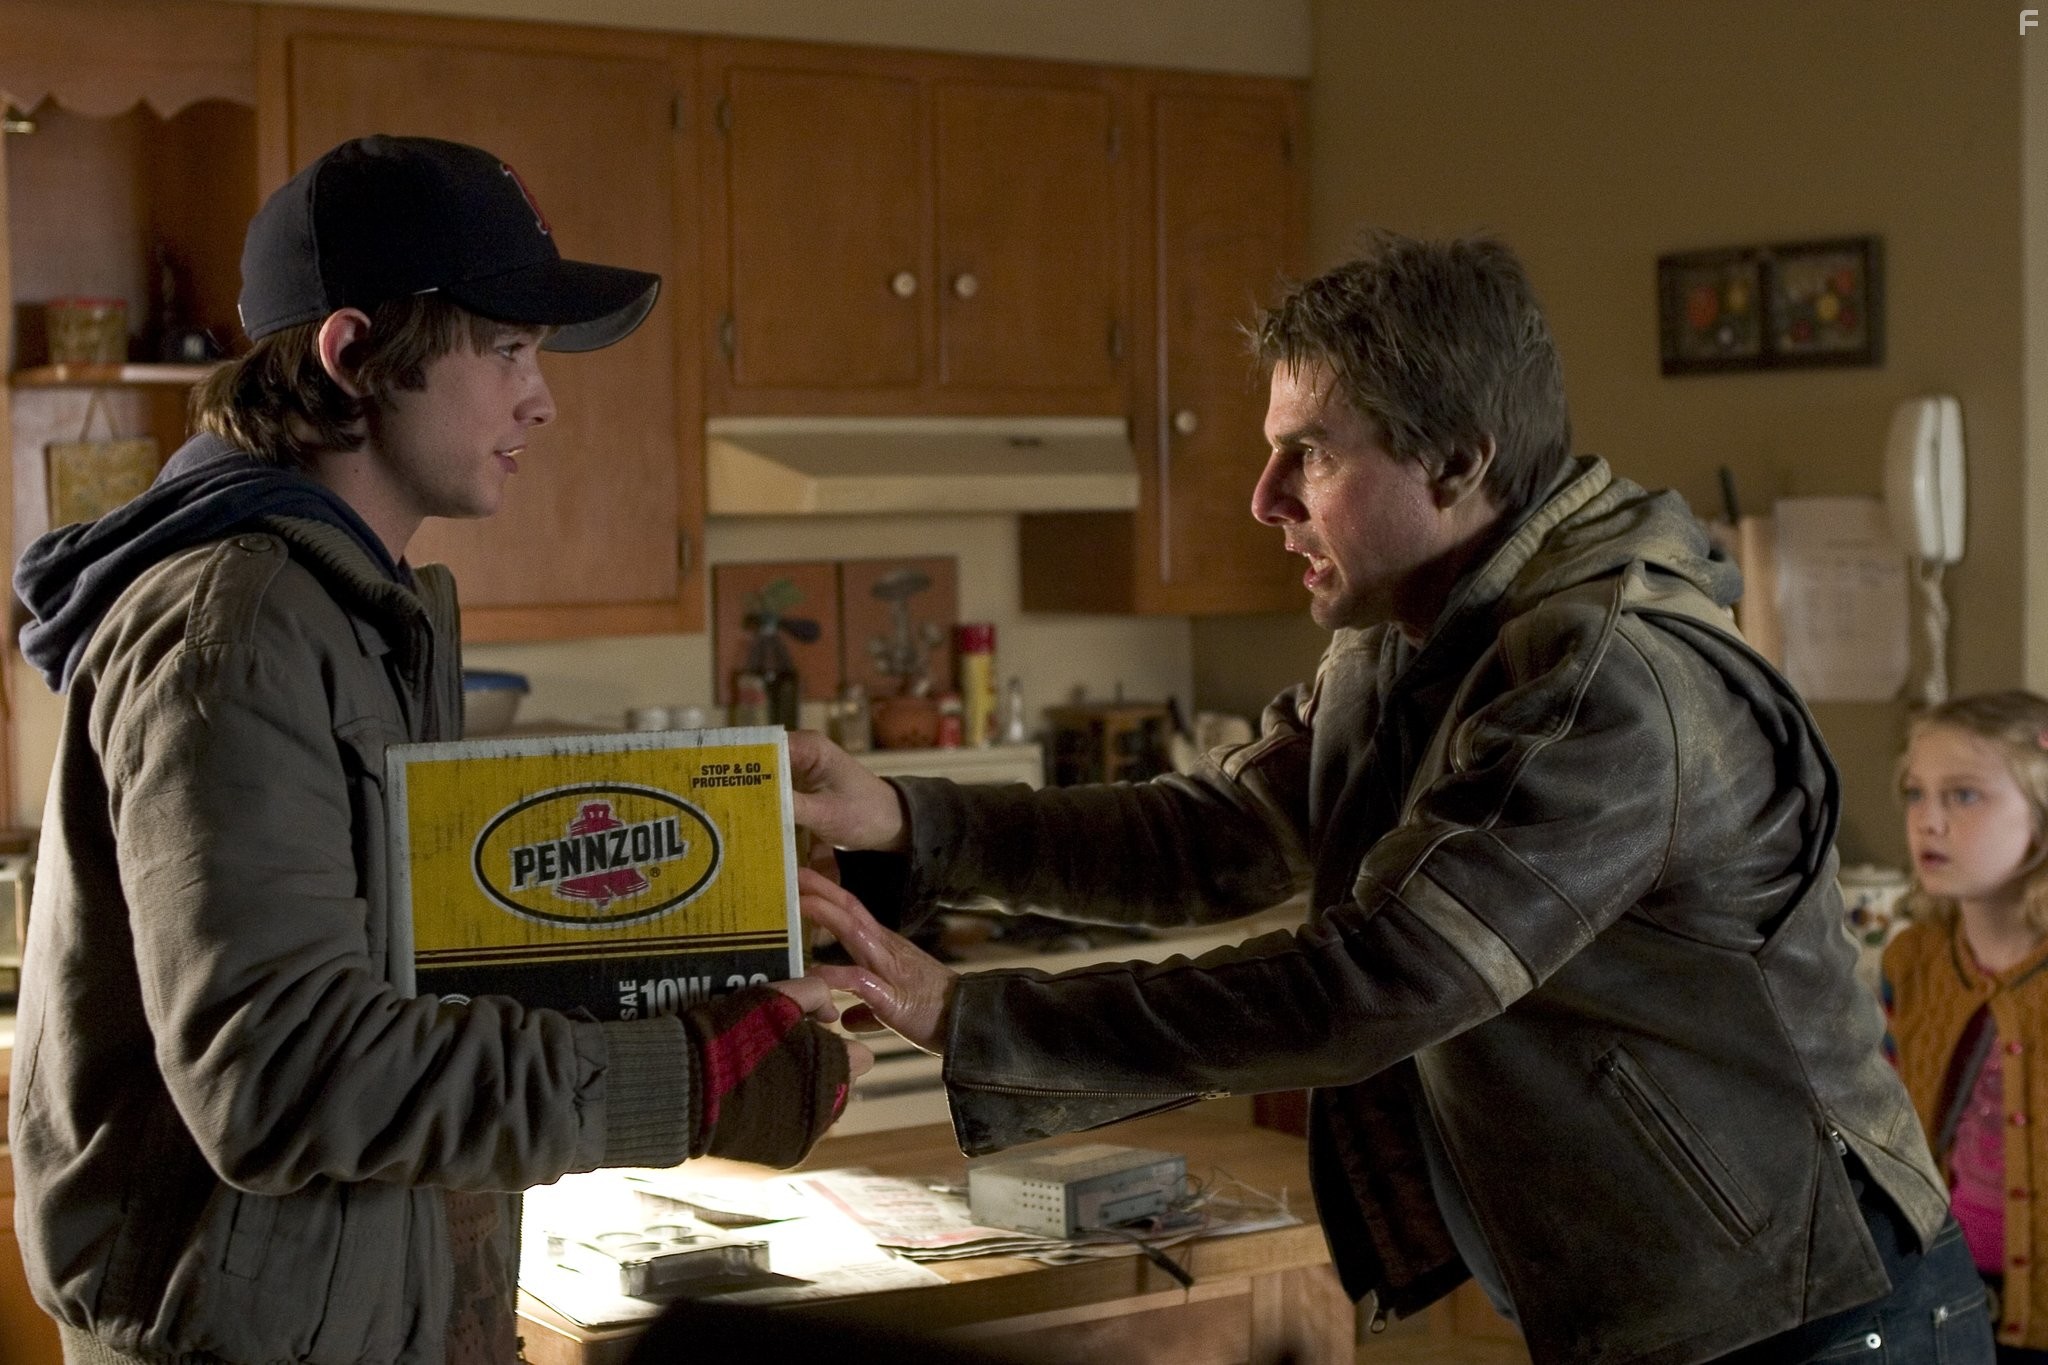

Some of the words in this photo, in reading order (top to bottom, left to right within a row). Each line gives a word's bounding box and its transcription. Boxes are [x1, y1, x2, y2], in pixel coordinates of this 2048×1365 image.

[701, 763, 731, 776] STOP
[733, 763, 743, 774] &
[745, 762, 762, 774] GO
[513, 818, 686, 888] PENNZOIL
[619, 979, 639, 1022] SAE
